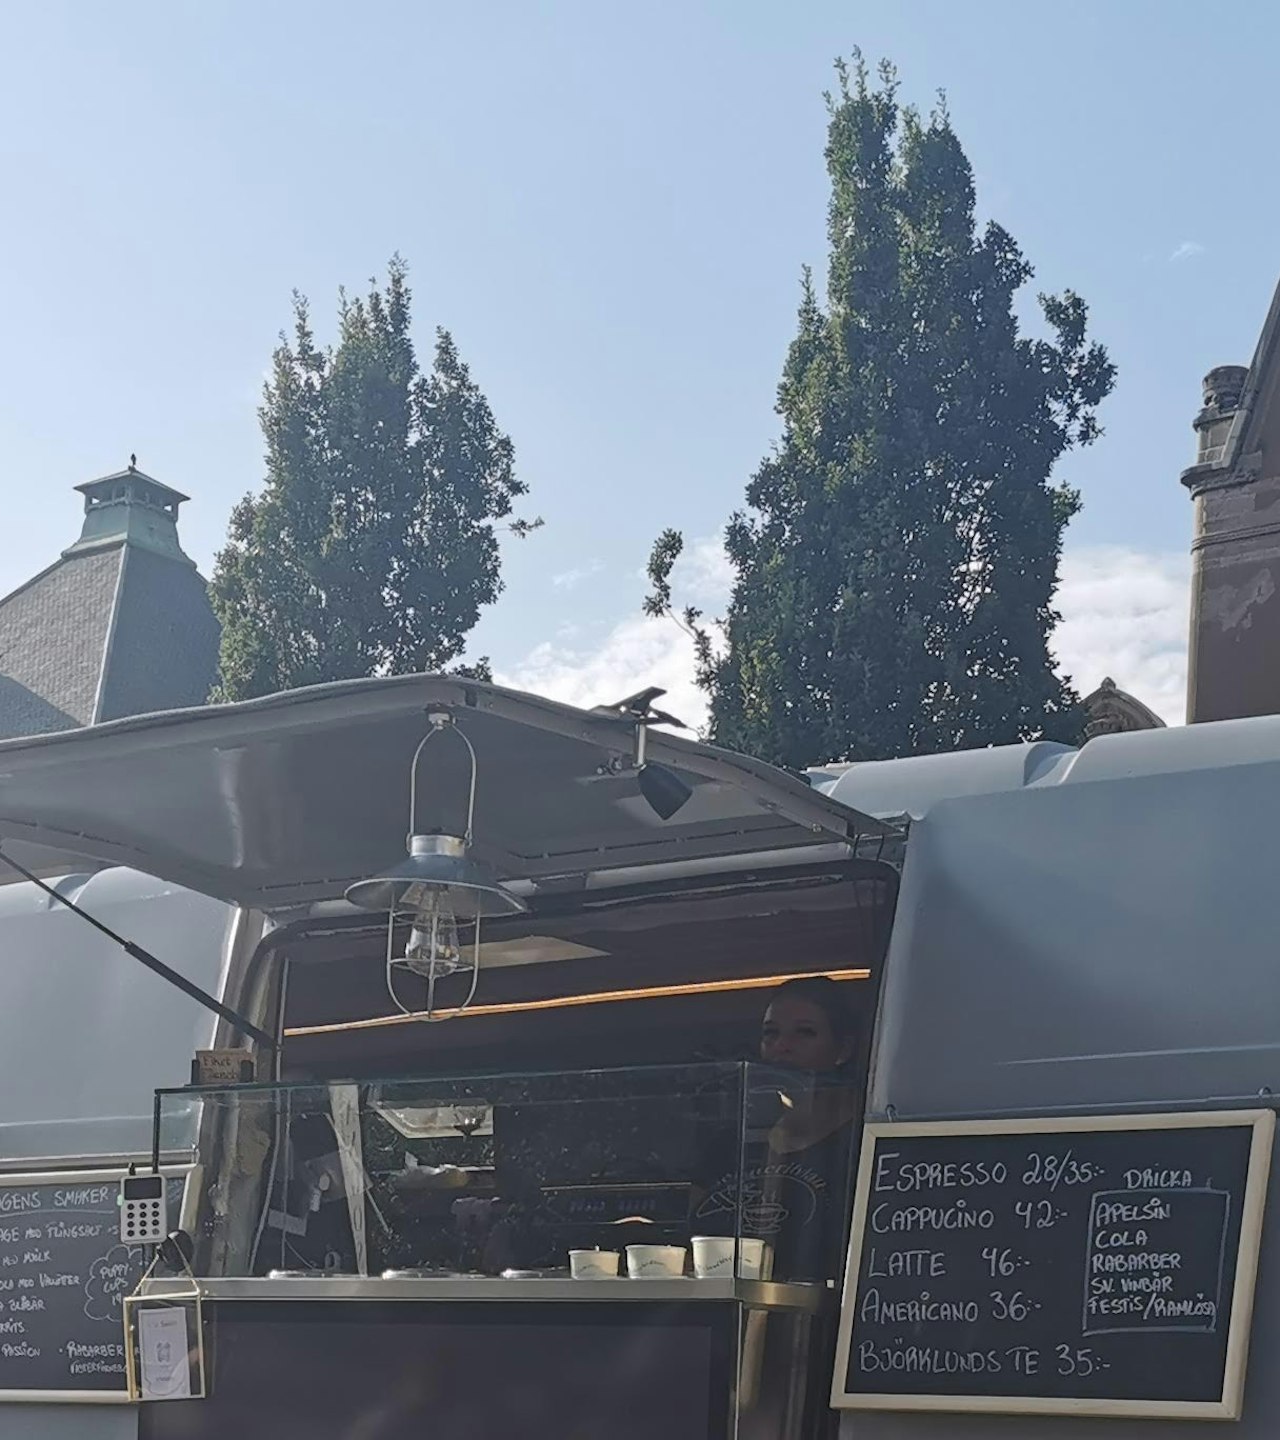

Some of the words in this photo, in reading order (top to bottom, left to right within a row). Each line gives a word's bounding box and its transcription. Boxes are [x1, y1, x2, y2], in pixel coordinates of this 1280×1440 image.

[875, 1153, 1007, 1192] ESPRESSO
[1123, 1164, 1192, 1189] DRICKA
[872, 1200, 994, 1233] CAPPUCINO
[1096, 1198, 1170, 1227] APELSIN
[1095, 1230, 1148, 1249] COLA
[868, 1248, 947, 1278] LATTE
[1092, 1253, 1181, 1273] RABARBER
[1120, 1272, 1173, 1292] VINBÄR
[860, 1288, 978, 1325] AMERICANO
[859, 1337, 1001, 1373] BJÖRKLUNDS
[1009, 1346, 1039, 1375] TE
